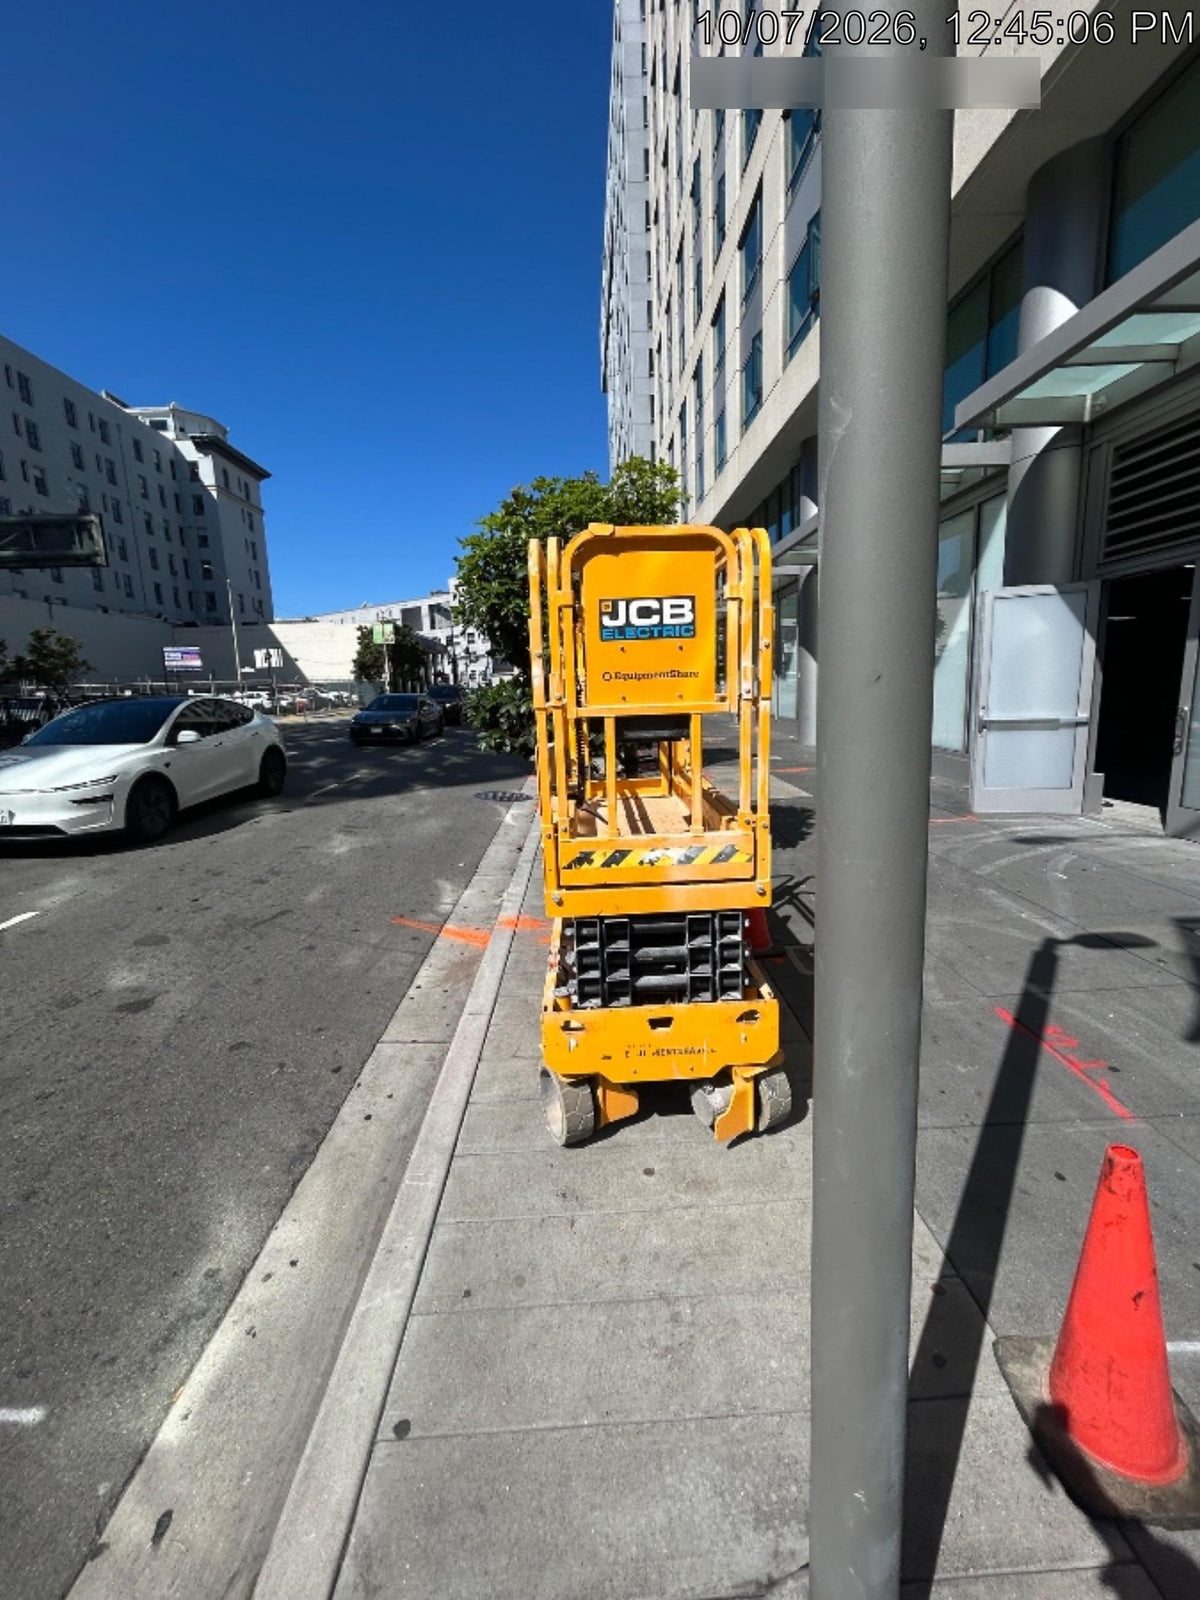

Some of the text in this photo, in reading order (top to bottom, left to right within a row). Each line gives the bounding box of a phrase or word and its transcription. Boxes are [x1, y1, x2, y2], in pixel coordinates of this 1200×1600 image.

[602, 598, 694, 627] JCB
[602, 625, 694, 640] ELECTRIC
[614, 669, 699, 681] EquipmentShare
